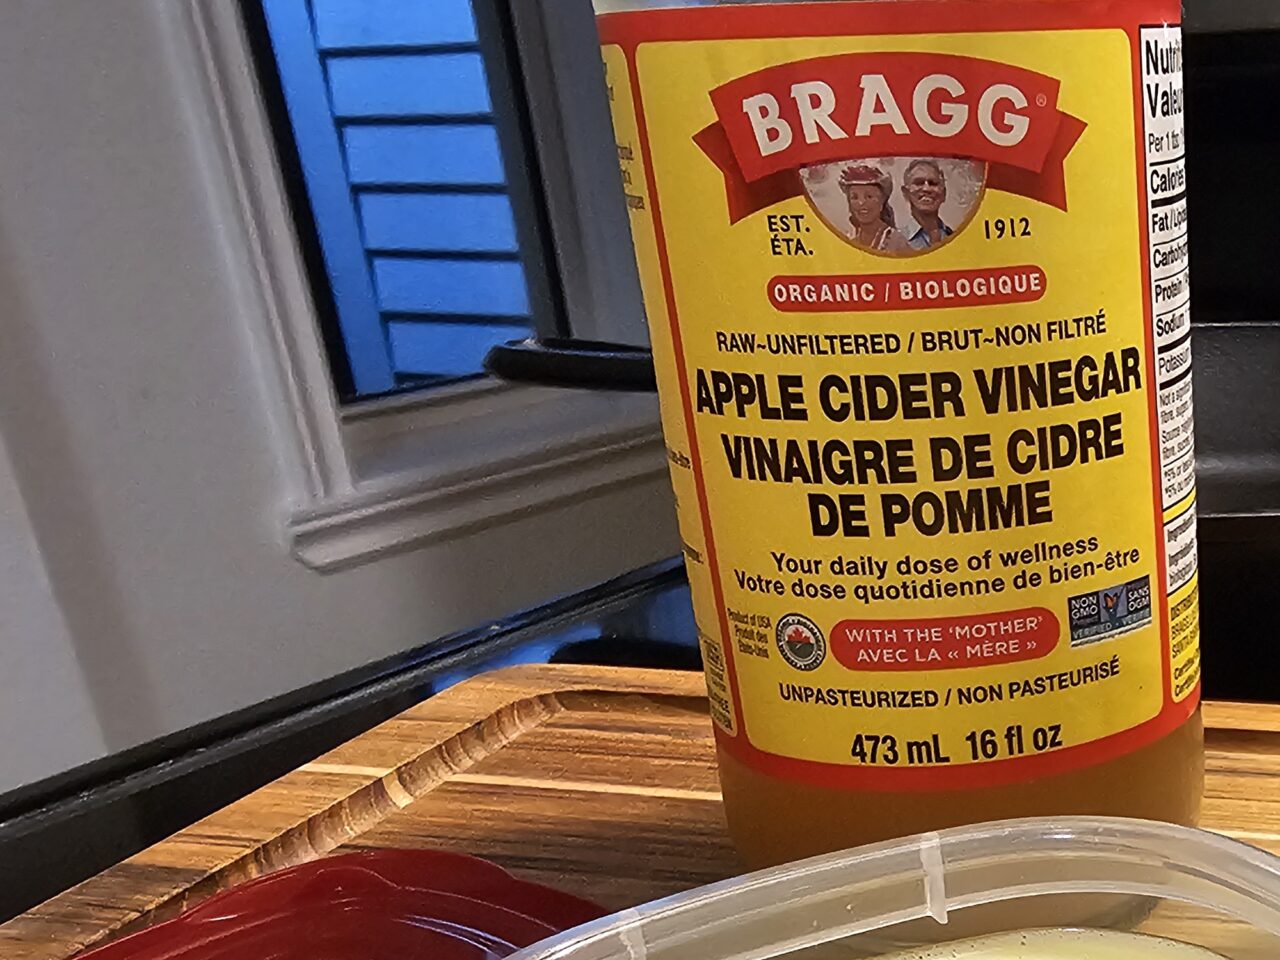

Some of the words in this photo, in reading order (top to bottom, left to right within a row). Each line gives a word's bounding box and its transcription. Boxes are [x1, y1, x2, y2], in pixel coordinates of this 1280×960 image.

[742, 73, 1031, 157] BRAGG
[767, 214, 810, 234] EST.
[984, 217, 1032, 240] 1912
[1152, 211, 1169, 233] Fat
[770, 236, 814, 256] ÉTA.
[774, 282, 875, 303] ORGANIC
[900, 272, 1041, 300] BIOLOGIQUE
[1046, 308, 1107, 342] FILTRÉ
[696, 367, 809, 422] APPLE
[819, 370, 966, 424] CIDER
[973, 346, 1142, 415] VINEGAR
[720, 433, 917, 486] VINAIGRE
[929, 433, 995, 482] DE
[1006, 412, 1124, 475] CIDRE
[807, 492, 870, 538] DE
[880, 479, 1053, 537] POMME
[770, 551, 822, 574] Your
[830, 555, 888, 580] daily
[896, 555, 959, 575] dose
[967, 549, 992, 571] of
[999, 536, 1099, 568] wellness
[734, 569, 786, 596] Votre
[791, 578, 846, 600] dose
[853, 576, 1005, 604] quotidienne
[1013, 569, 1042, 590] de
[1049, 548, 1140, 584] bien-être
[1071, 596, 1097, 609] NON
[1128, 585, 1149, 601] SANS
[1128, 596, 1150, 611] OGM
[1071, 605, 1098, 619] GMO
[846, 629, 896, 643] WITH
[904, 627, 942, 642] THE
[857, 649, 908, 662] AVEC
[915, 648, 941, 662] LA
[966, 639, 1020, 659] MÈRE
[778, 682, 939, 708] UNPASTEURIZED
[957, 684, 1003, 705] NON
[1008, 654, 1120, 699] PASTEURISÉ
[851, 734, 899, 764] 473
[906, 734, 950, 764] mL
[965, 729, 998, 761] 16
[1004, 724, 1024, 756] fl
[1032, 723, 1063, 751] oz
